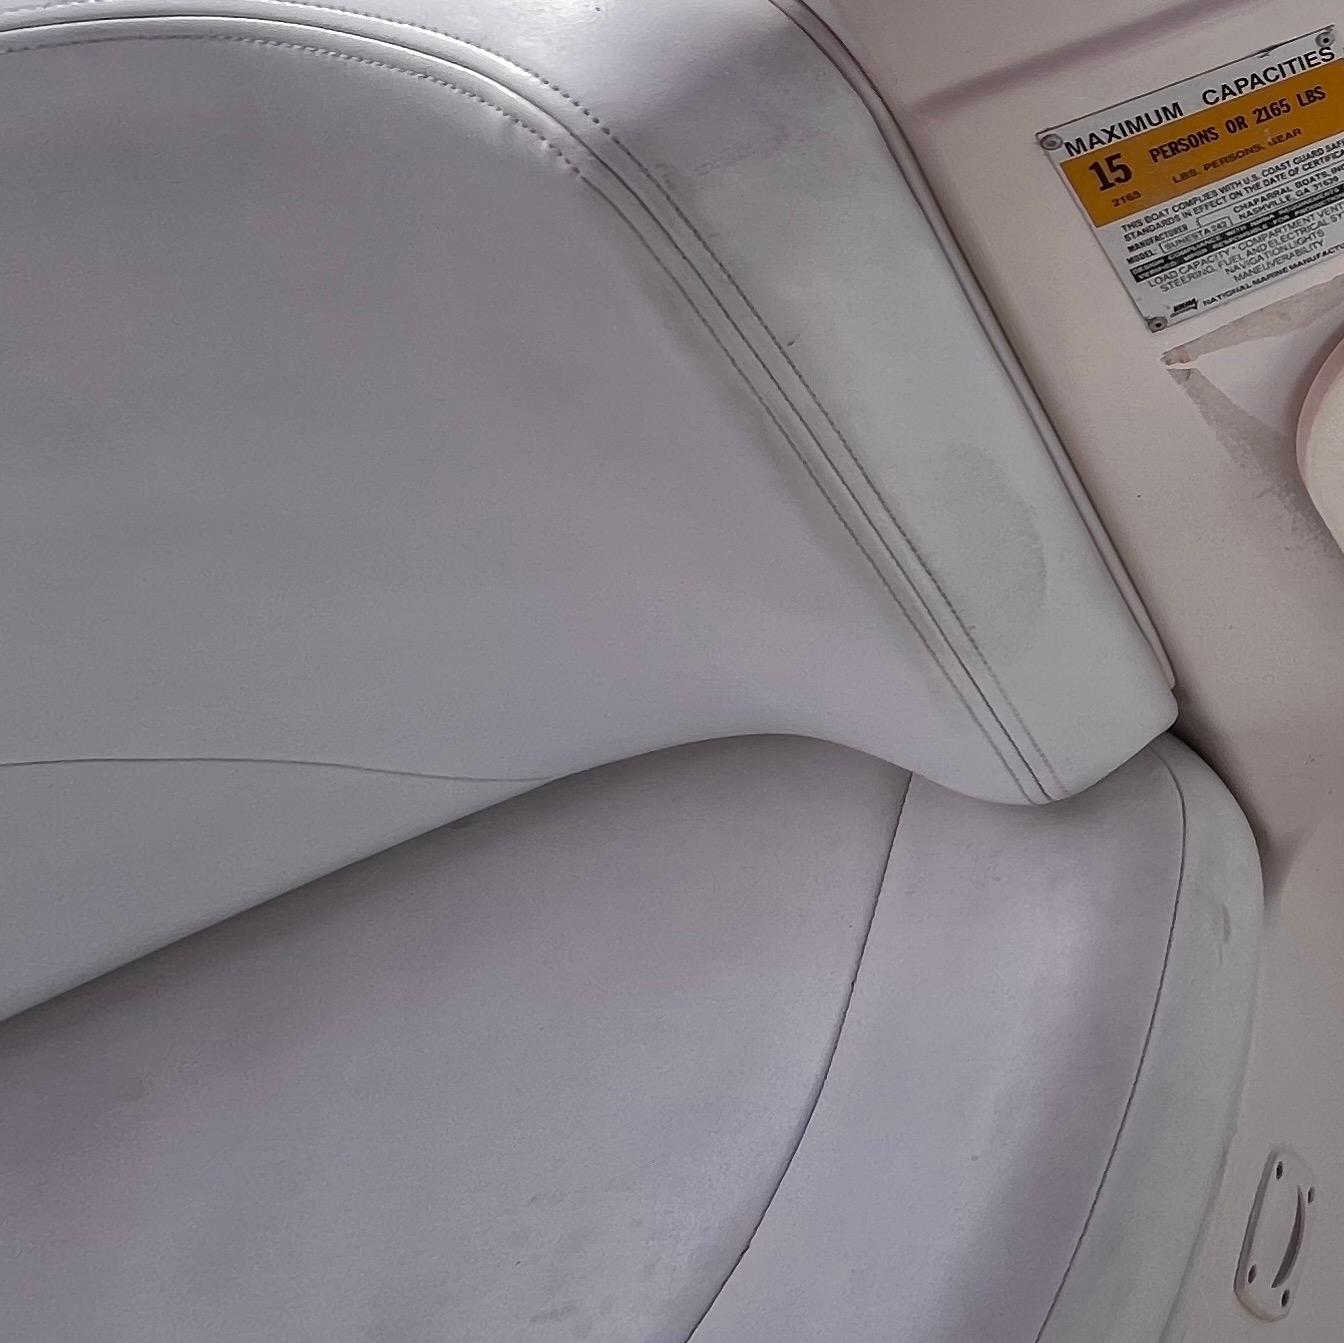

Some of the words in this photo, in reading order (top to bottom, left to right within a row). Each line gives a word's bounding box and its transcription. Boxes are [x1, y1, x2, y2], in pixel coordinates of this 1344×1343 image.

[1063, 101, 1183, 157] MAXIMUM
[1201, 44, 1335, 105] CAPACITIES
[1088, 152, 1132, 191] 15
[1148, 126, 1219, 163] PERSONS
[1224, 115, 1248, 133] OR
[1251, 97, 1290, 124] 2165
[1295, 85, 1326, 106] LBS
[1120, 218, 1143, 231] THIS
[1143, 207, 1169, 223] BOAT
[1171, 189, 1218, 212] COMPLIES
[1217, 179, 1242, 193] WITH
[1242, 173, 1260, 184] U.S.
[1261, 159, 1291, 177] COAST
[1292, 147, 1324, 164] GUARD
[1123, 214, 1181, 241] STANDARDS
[1181, 209, 1192, 218] IN
[1192, 195, 1227, 214] EFFECT
[1228, 189, 1243, 200] ON
[1243, 181, 1262, 193] THE
[1262, 172, 1287, 186] DATE
[1287, 166, 1299, 176] OF
[1232, 186, 1292, 213] CHAPARRAL
[1147, 270, 1178, 287] LOAD
[1178, 247, 1229, 274] CAPACITY
[1237, 212, 1315, 250] COMPARTMENT
[1217, 253, 1245, 269] FUEL
[1246, 242, 1267, 257] AND
[1267, 218, 1328, 248] ELECTRICAL
[1224, 244, 1288, 275] NAVIGATION
[1287, 228, 1324, 249] LIGHTS
